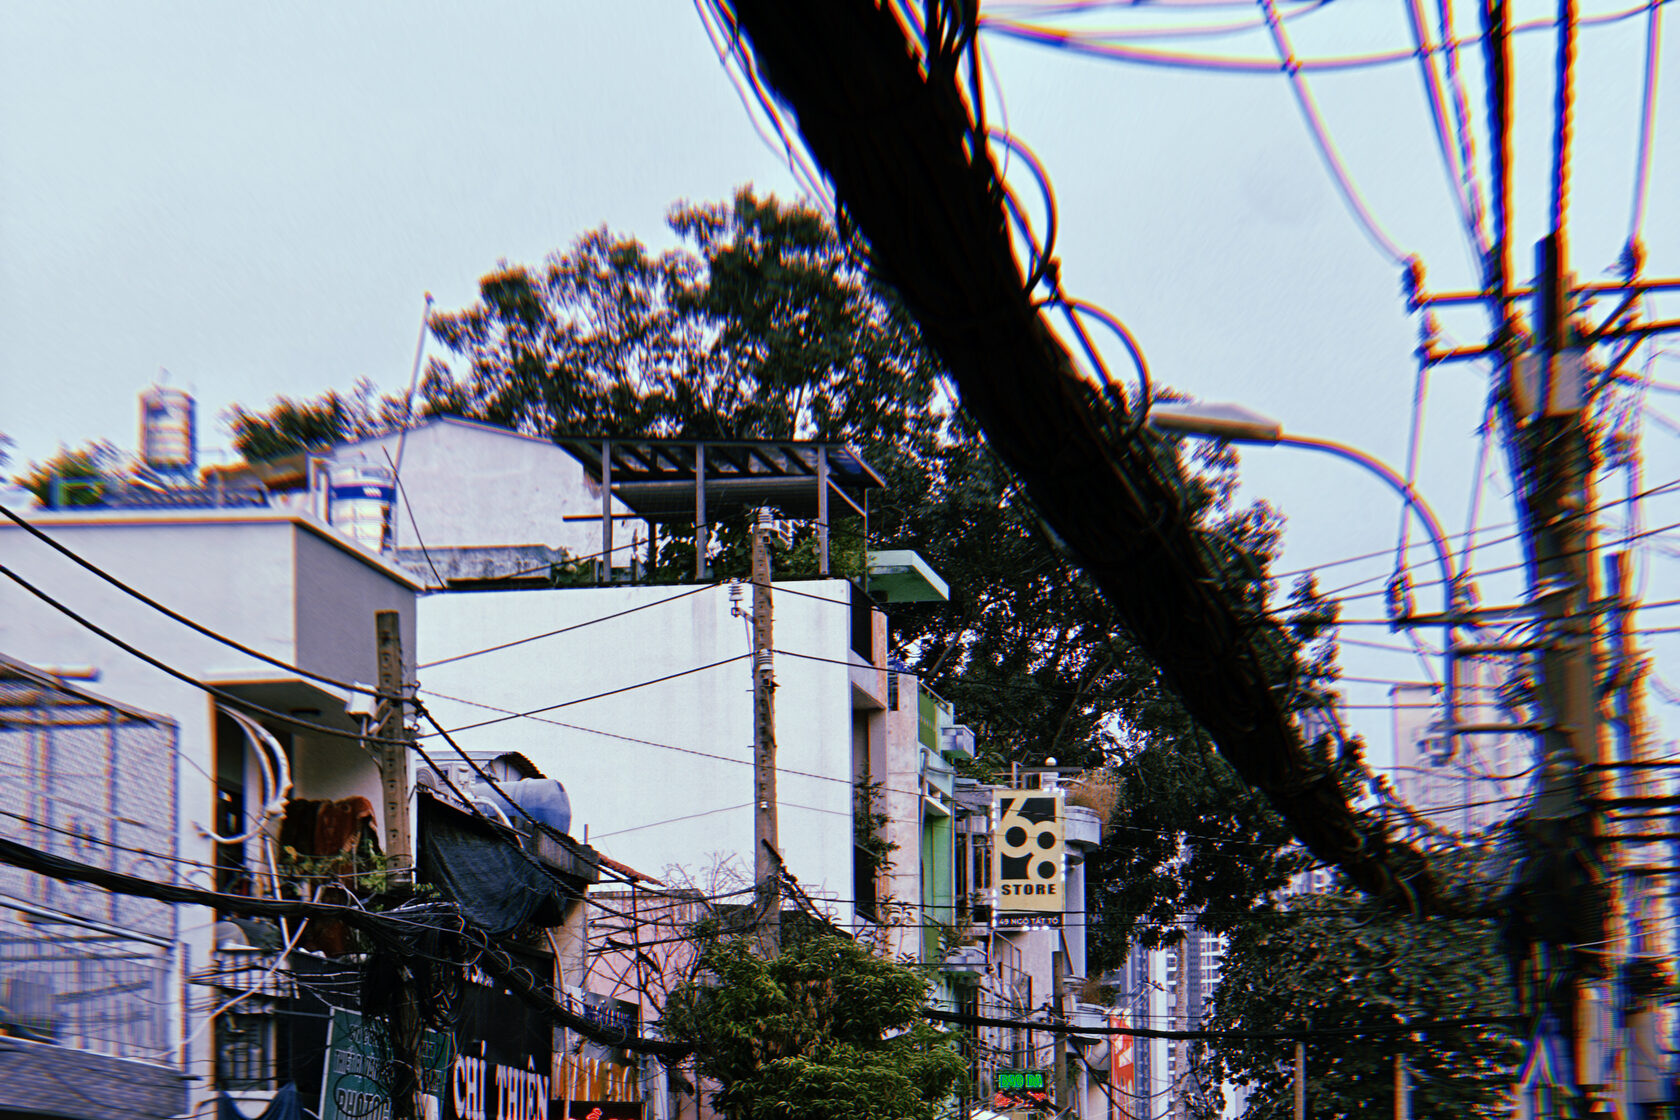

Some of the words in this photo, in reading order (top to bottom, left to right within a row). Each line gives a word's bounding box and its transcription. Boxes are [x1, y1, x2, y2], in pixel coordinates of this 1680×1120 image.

[1001, 884, 1056, 895] STORE
[1011, 916, 1030, 925] NGÔ
[1031, 915, 1046, 925] TẤT
[1047, 915, 1059, 925] TỐ
